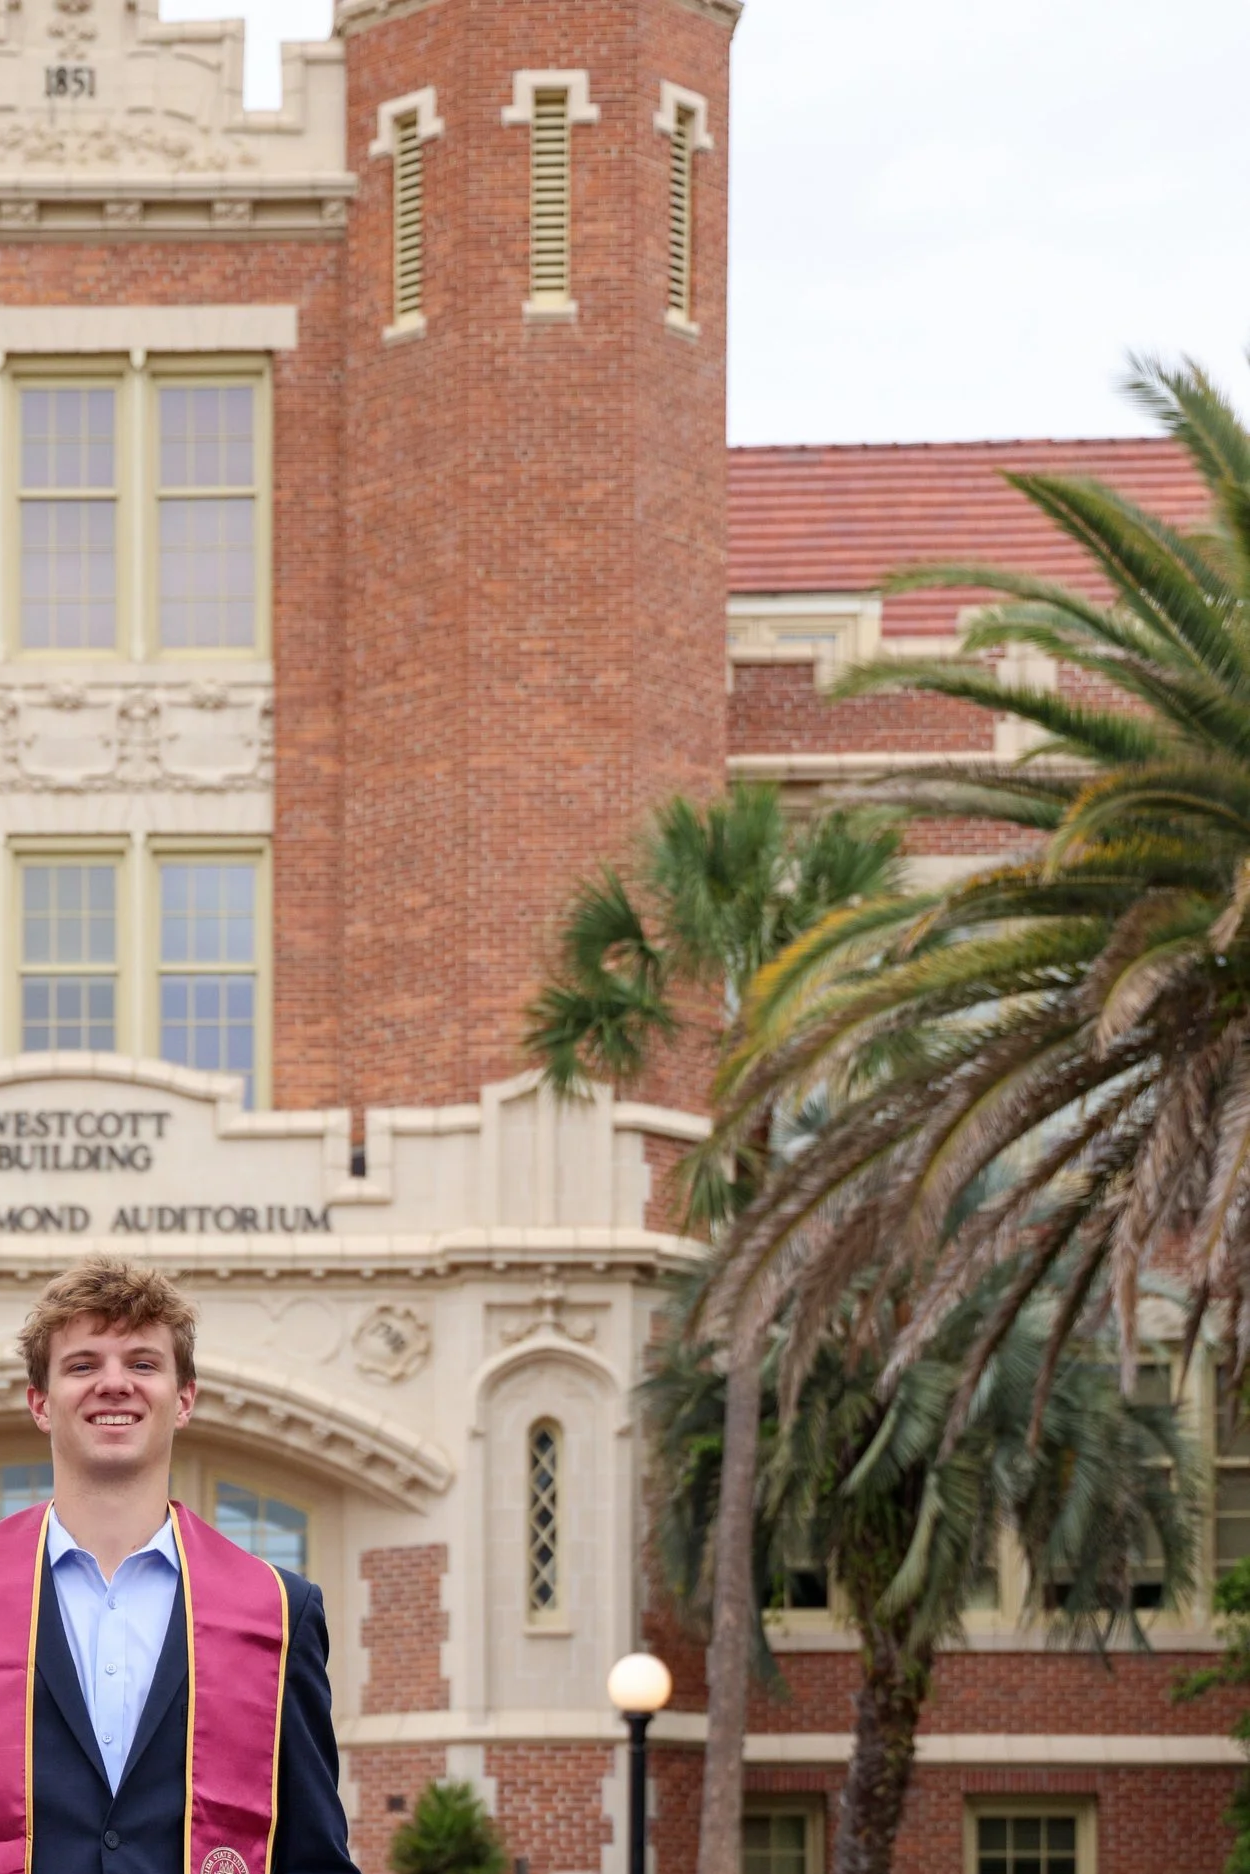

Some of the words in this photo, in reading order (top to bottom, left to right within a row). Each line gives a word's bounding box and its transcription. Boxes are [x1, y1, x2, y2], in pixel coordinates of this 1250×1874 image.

[44, 65, 96, 98] 1851
[110, 1204, 333, 1233] AUDITORIUM
[213, 1851, 232, 1860] STATE
